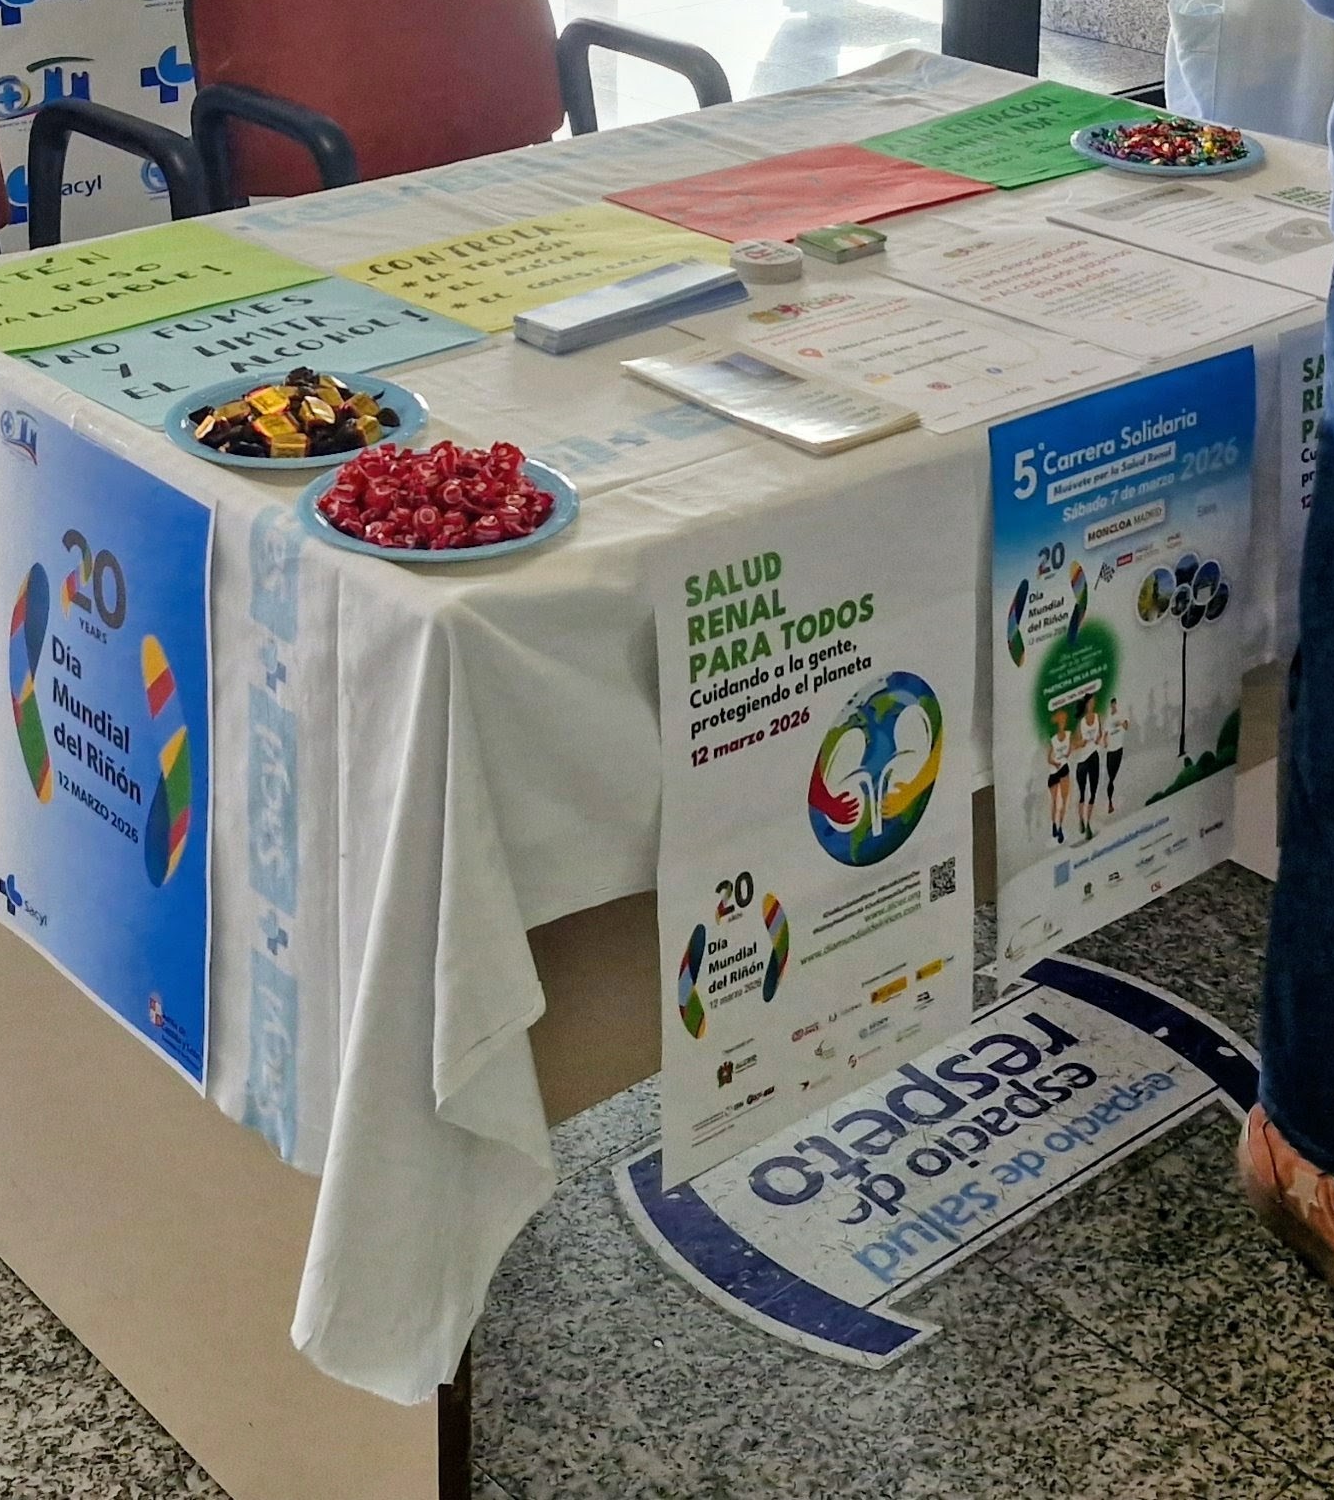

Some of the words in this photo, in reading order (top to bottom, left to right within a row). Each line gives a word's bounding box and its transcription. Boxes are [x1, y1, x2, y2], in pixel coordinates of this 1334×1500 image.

[58, 261, 164, 292] PESO
[159, 292, 315, 340] FUMES
[192, 312, 347, 359] LIMITA
[121, 379, 192, 402] EL
[229, 309, 433, 376] ALCOHOL!
[1042, 438, 1116, 476] Carrera
[1120, 407, 1198, 451] Solidaria
[1062, 492, 1108, 523] Sábado
[1110, 489, 1120, 505] 7
[1120, 482, 1137, 502] de
[1138, 472, 1176, 494] marzo
[1180, 437, 1240, 482] 2026
[1087, 518, 1134, 544] MONCLOA
[1133, 505, 1163, 527] MADRID
[61, 526, 128, 631] 20
[684, 551, 784, 609] SALUD
[1037, 541, 1066, 573] 20
[687, 588, 788, 647] RENAL
[1027, 597, 1065, 620] Mundial
[1027, 620, 1042, 635] del
[1042, 610, 1069, 629] Riñón
[1028, 591, 1044, 605] Día
[51, 633, 83, 680] Día
[79, 616, 109, 645] YEARS
[689, 630, 772, 685] PARA
[780, 591, 876, 652] TODOS
[689, 664, 770, 709] Cuidando
[773, 663, 785, 679] a
[788, 652, 805, 675] la
[807, 638, 858, 672] gente,
[690, 684, 791, 741] protegiendo
[794, 673, 809, 696] el
[812, 653, 873, 695] planeta
[52, 677, 131, 756] Mundial
[690, 745, 710, 769] 12
[712, 727, 765, 761] marzo
[768, 706, 811, 738] 2026
[53, 721, 84, 763] del
[86, 742, 144, 806] Riñón
[57, 771, 72, 795] 12
[70, 779, 111, 823] MARZO
[109, 805, 141, 845] 2026
[715, 870, 755, 918] 20
[707, 936, 729, 956] Día
[707, 941, 758, 976] Mundial
[707, 976, 728, 996] del
[729, 959, 765, 988] Riñón
[748, 1009, 1084, 1209] respeto
[905, 1061, 1101, 1183] espacio
[1041, 1066, 1179, 1156] espacio
[995, 1150, 1045, 1189] de
[850, 1182, 1002, 1287] salud
